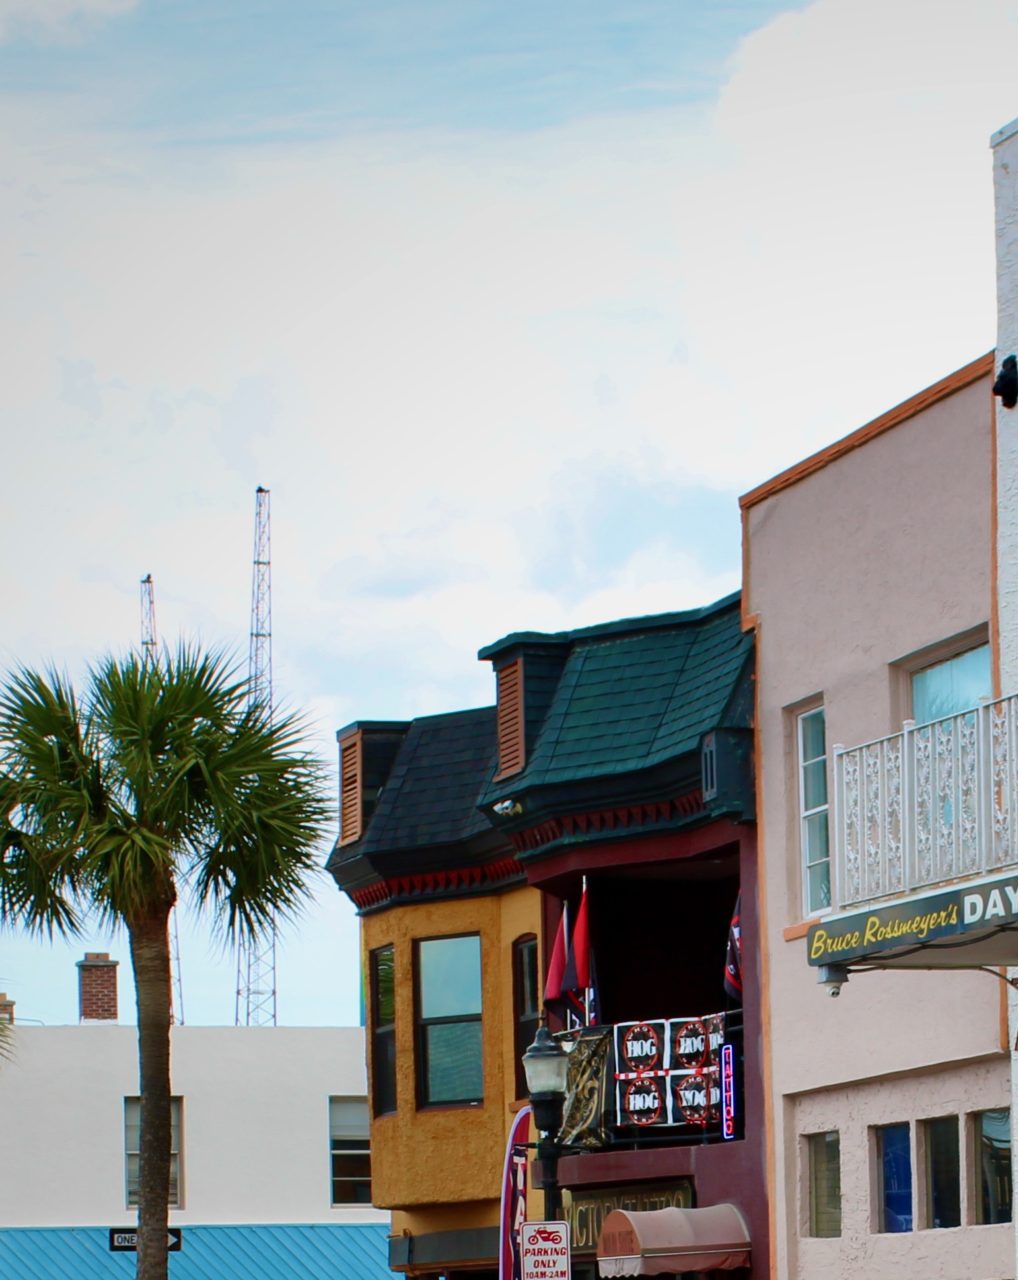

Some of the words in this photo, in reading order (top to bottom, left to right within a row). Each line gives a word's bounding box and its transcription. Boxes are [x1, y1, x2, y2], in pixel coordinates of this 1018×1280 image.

[810, 928, 861, 960] Bruce
[863, 904, 958, 947] Rossmeyer's
[626, 1038, 657, 1058] HOG
[724, 1049, 734, 1134] TATTOO
[629, 1092, 659, 1111] HOG
[116, 1234, 137, 1245] ONE
[524, 1246, 567, 1257] PARKING
[533, 1259, 558, 1269] ONLY
[525, 1270, 567, 1279] 10AM-2AM
